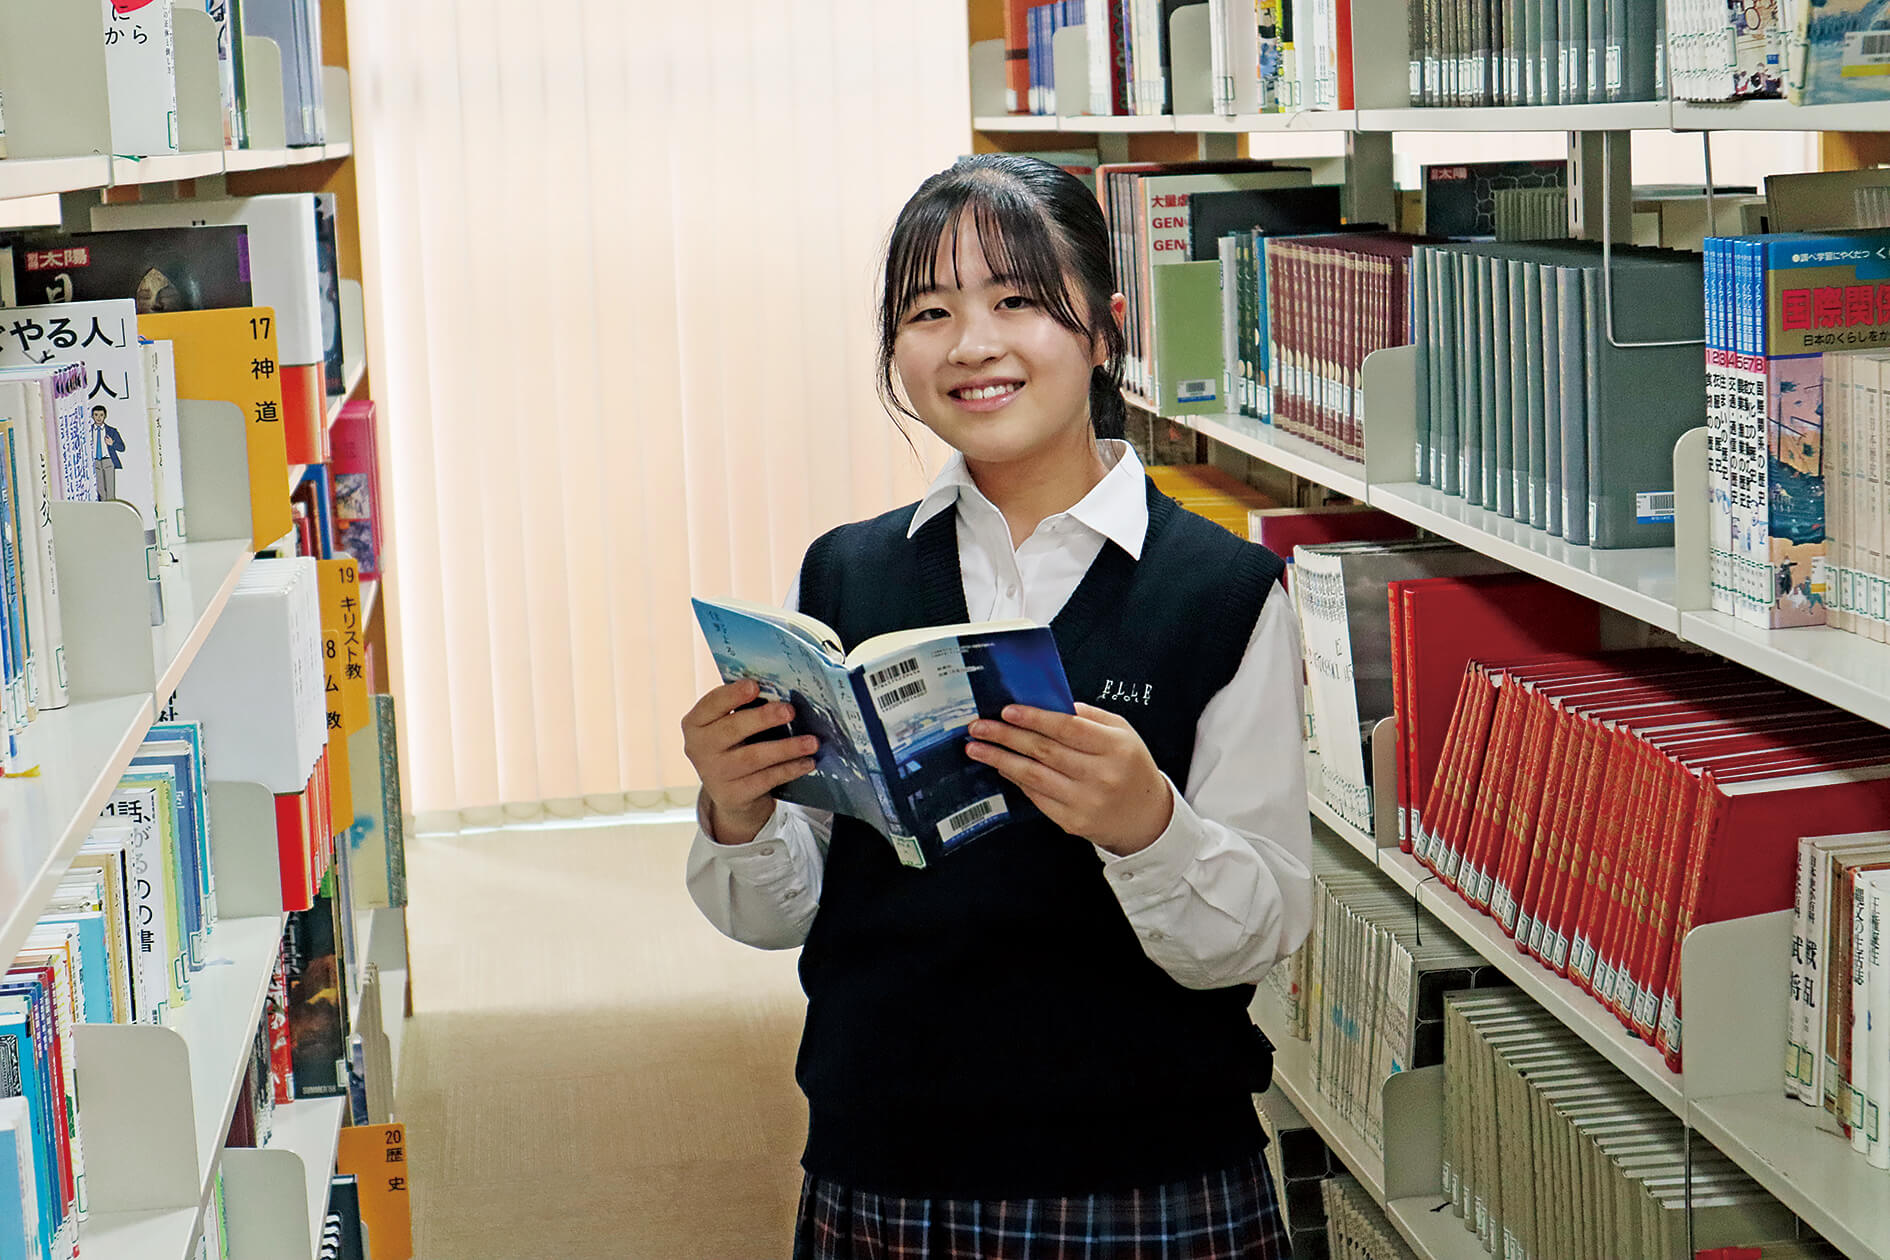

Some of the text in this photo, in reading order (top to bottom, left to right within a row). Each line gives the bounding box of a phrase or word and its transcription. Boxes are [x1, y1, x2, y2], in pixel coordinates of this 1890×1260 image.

[104, 24, 148, 45] から
[1152, 216, 1188, 229] GEN
[0, 316, 127, 351] やる人」
[249, 317, 271, 341] 17
[251, 358, 279, 424] 神道
[338, 567, 355, 584] 19
[340, 596, 363, 680] キリスト教
[385, 1130, 402, 1145] 20
[385, 1148, 406, 1192] 歴史
